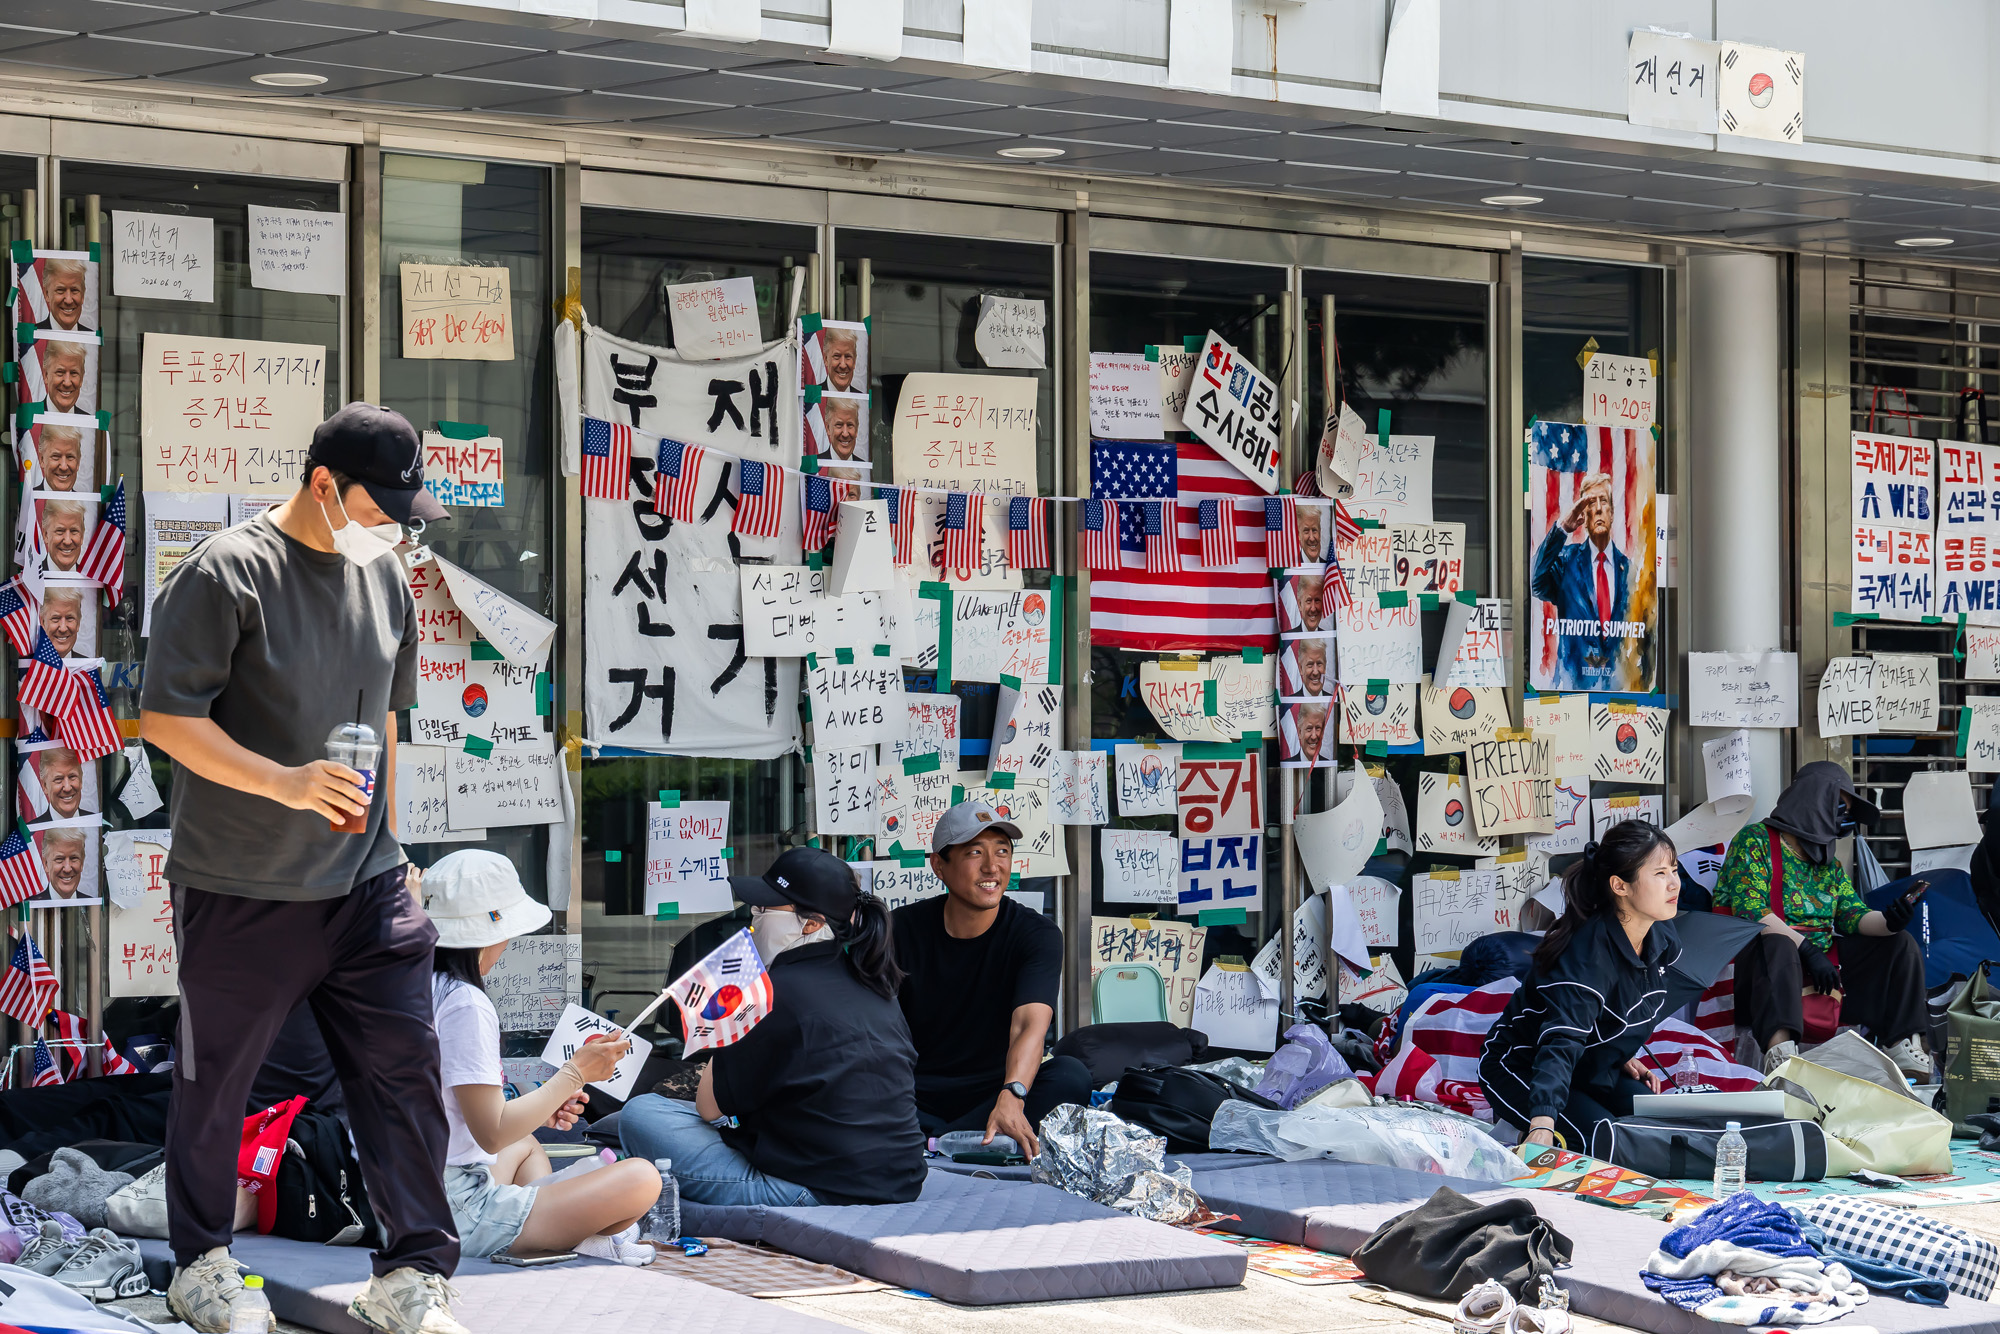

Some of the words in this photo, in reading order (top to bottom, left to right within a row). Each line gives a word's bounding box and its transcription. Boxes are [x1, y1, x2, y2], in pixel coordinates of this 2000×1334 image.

[1635, 55, 1704, 98] 재선거
[126, 219, 179, 248] 재선거
[410, 270, 490, 298] 재선거
[676, 291, 699, 310] 공정한
[701, 287, 724, 302] 선거를
[159, 351, 245, 385] 투표용지
[253, 358, 320, 386] 지키자!
[1590, 360, 1616, 382] 최소
[1623, 364, 1647, 388] 상주
[183, 397, 272, 430] 증거보존
[906, 395, 984, 430] 투표용지
[987, 408, 1033, 431] 지키자!
[157, 446, 237, 483] 부정선거
[427, 442, 501, 486] 재선거
[923, 440, 997, 469] 증거보존
[1855, 439, 1931, 477] 국제기관
[1943, 448, 1984, 485] 꼬리
[1944, 537, 1986, 572] 몸통
[752, 572, 826, 607] 선관위
[1858, 571, 1931, 612] 국제수사
[772, 611, 816, 643] 대빵
[1546, 618, 1601, 637] PATRIOTIC
[1602, 620, 1646, 639] SUMMER
[419, 656, 466, 684] 부정선거
[492, 661, 538, 694] 재선거
[1121, 676, 1138, 698] K
[418, 719, 468, 742] 당일투표
[490, 720, 538, 741] 수개표
[826, 706, 884, 729] AWEB
[1611, 707, 1649, 728] 부정선거
[1451, 728, 1477, 744] 재선거
[828, 752, 868, 784] 한미
[1470, 738, 1550, 780] FREEDOM
[1569, 752, 1584, 761] free
[1613, 757, 1642, 775] 재선거
[912, 774, 950, 792] 부정선거
[1177, 754, 1260, 834] 증거
[911, 795, 947, 812] 재선거
[1476, 784, 1500, 829] IS
[1500, 779, 1534, 823] NOT
[679, 815, 723, 840] 없애고
[1110, 831, 1173, 852] 재선거
[1439, 830, 1466, 842] 재선거
[1528, 835, 1580, 852] Freedom
[679, 856, 725, 882] 수개표
[1178, 835, 1259, 905] 보전
[1421, 922, 1441, 947] for
[511, 1063, 555, 1080] 민주주의
